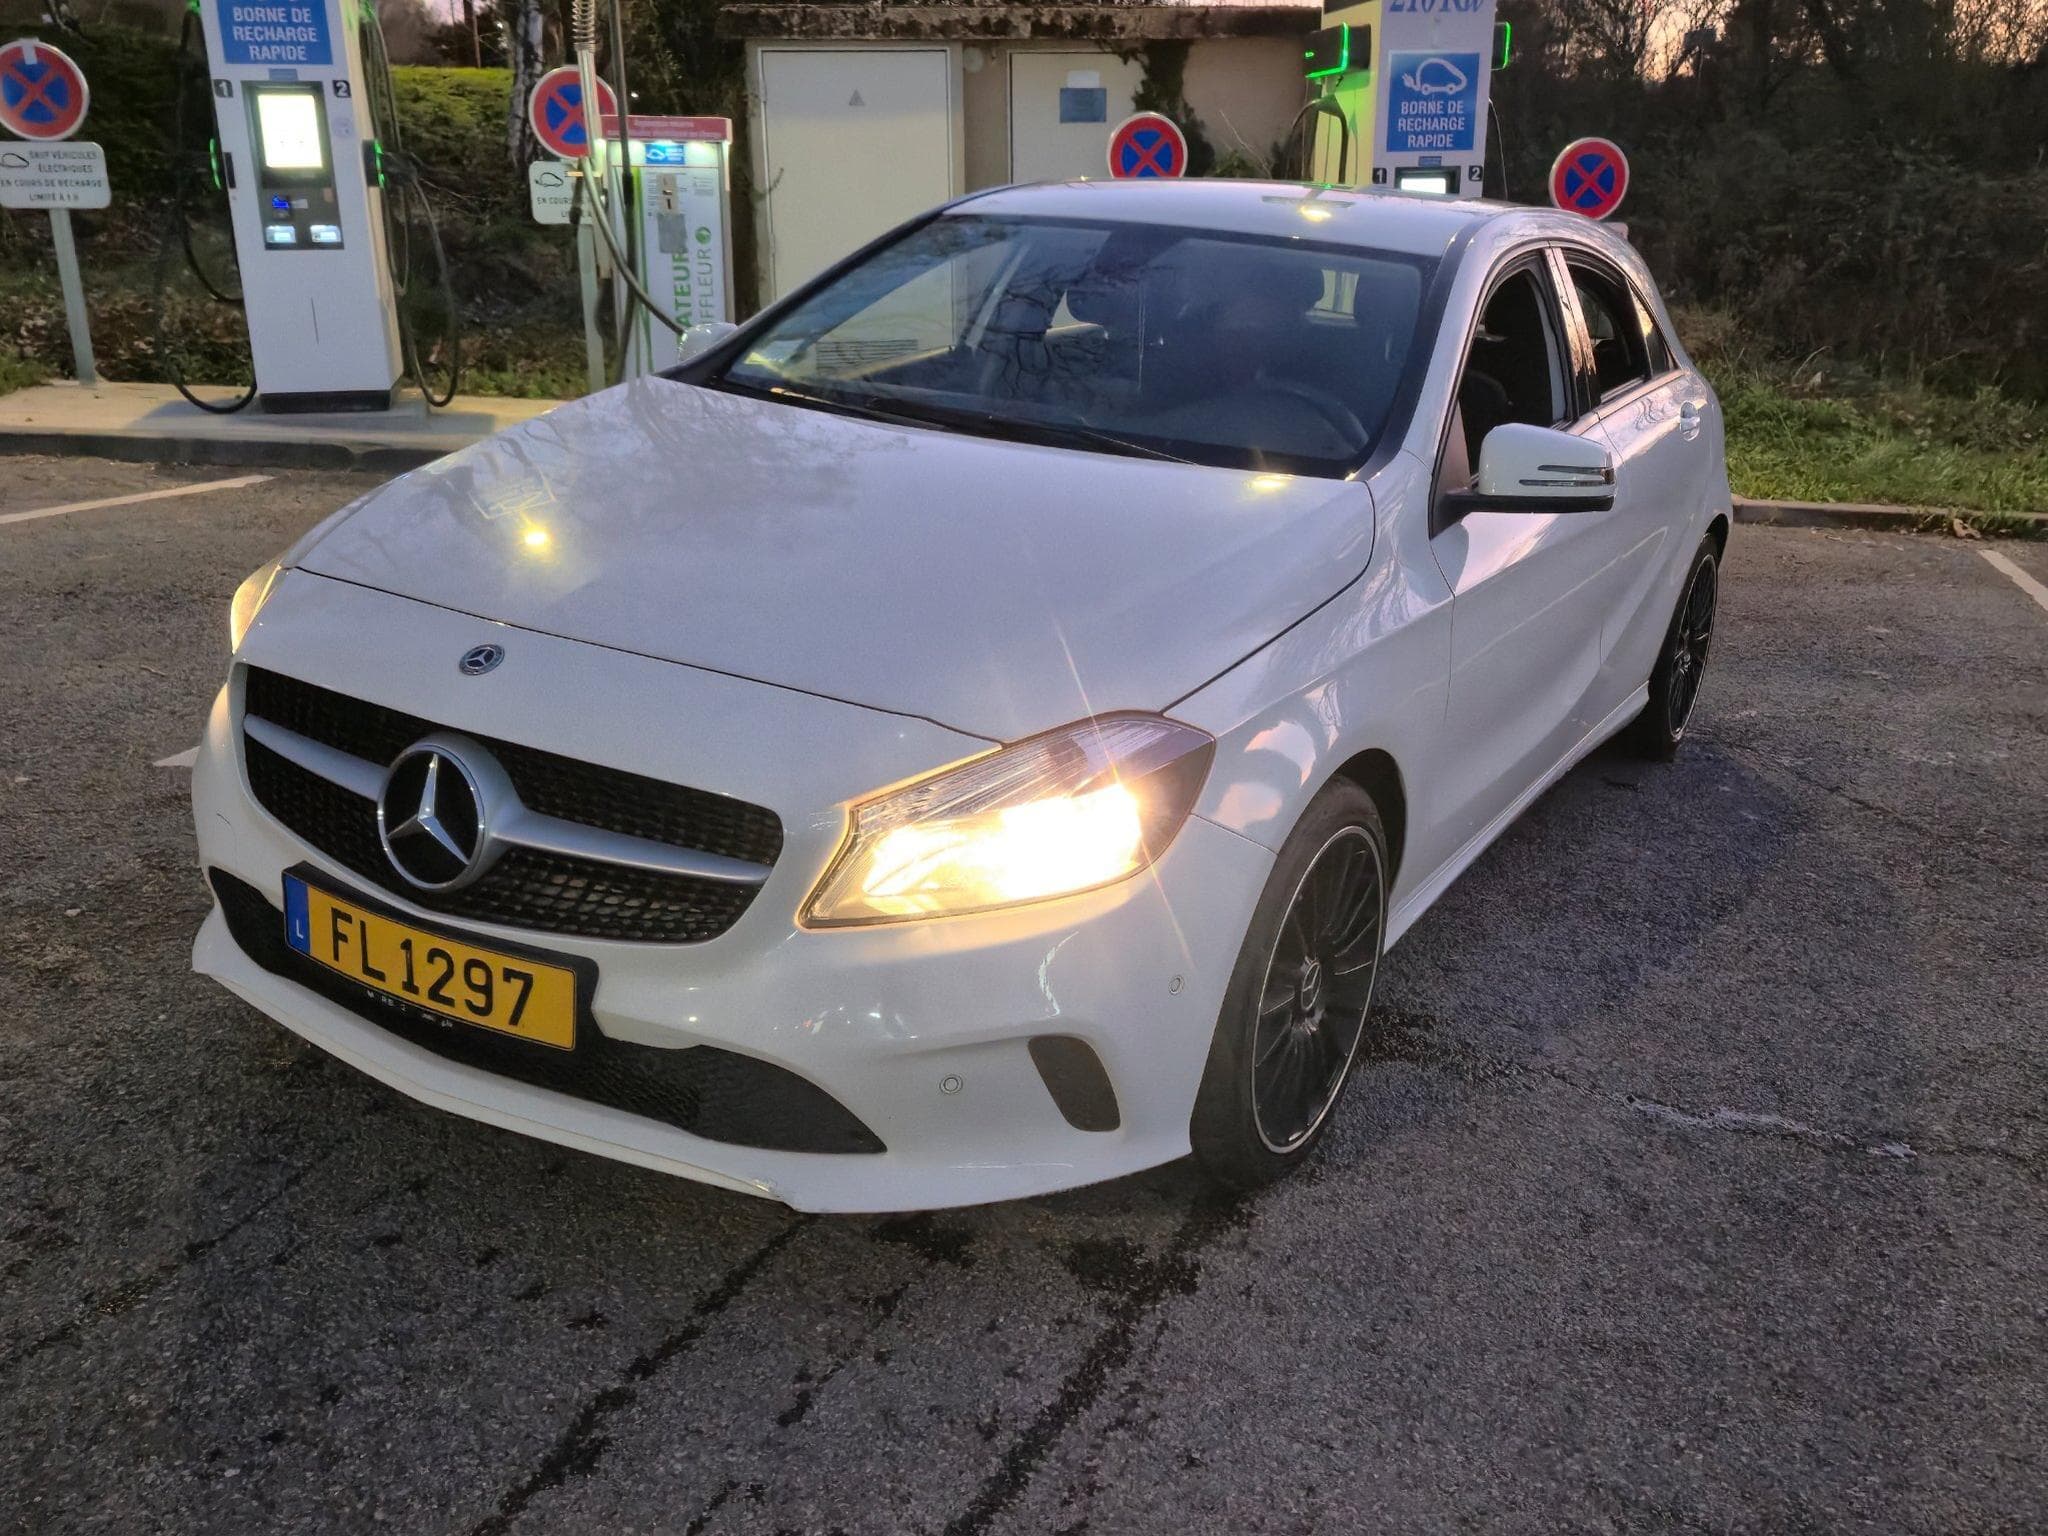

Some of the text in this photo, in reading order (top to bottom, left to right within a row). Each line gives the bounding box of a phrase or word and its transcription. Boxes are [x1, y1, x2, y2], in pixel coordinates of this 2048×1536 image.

[233, 7, 312, 23] BORNE DE
[233, 26, 317, 42] RECHARGE
[250, 45, 307, 60] RAPIDE
[218, 81, 229, 97] 1
[335, 81, 348, 96] 2
[1401, 101, 1464, 115] BORNE DE
[1398, 117, 1465, 132] RECHARGE
[1407, 134, 1454, 148] RAPIDE
[1376, 169, 1385, 182] 1
[1472, 168, 1481, 180] 2
[295, 919, 304, 940] L
